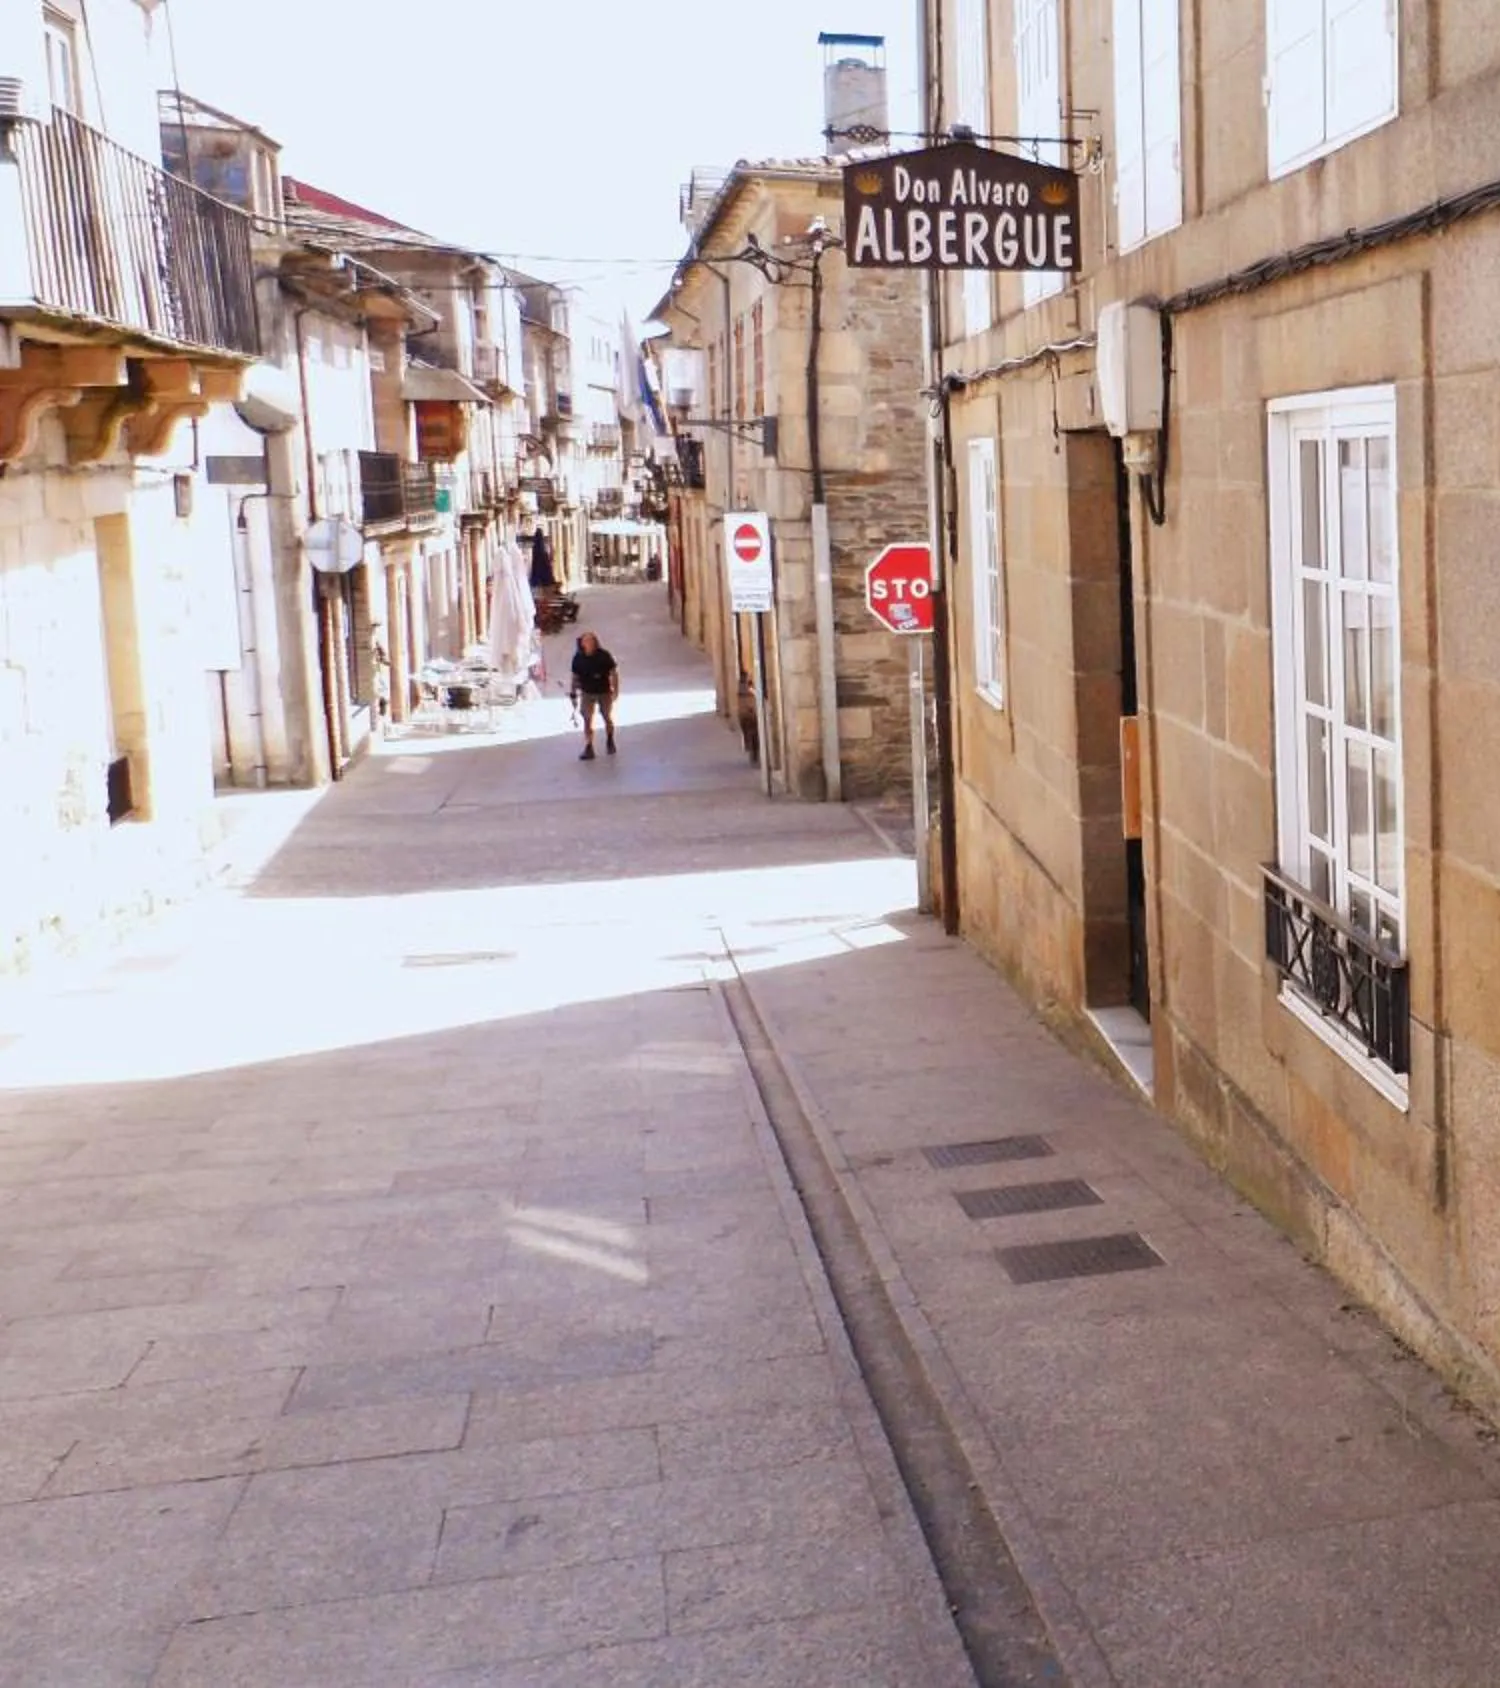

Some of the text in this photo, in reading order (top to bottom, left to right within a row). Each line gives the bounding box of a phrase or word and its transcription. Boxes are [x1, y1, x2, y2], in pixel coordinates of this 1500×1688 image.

[893, 165, 1030, 207] Don Alvaro
[854, 204, 1074, 268] ALBERGUE
[872, 577, 929, 600] STO
